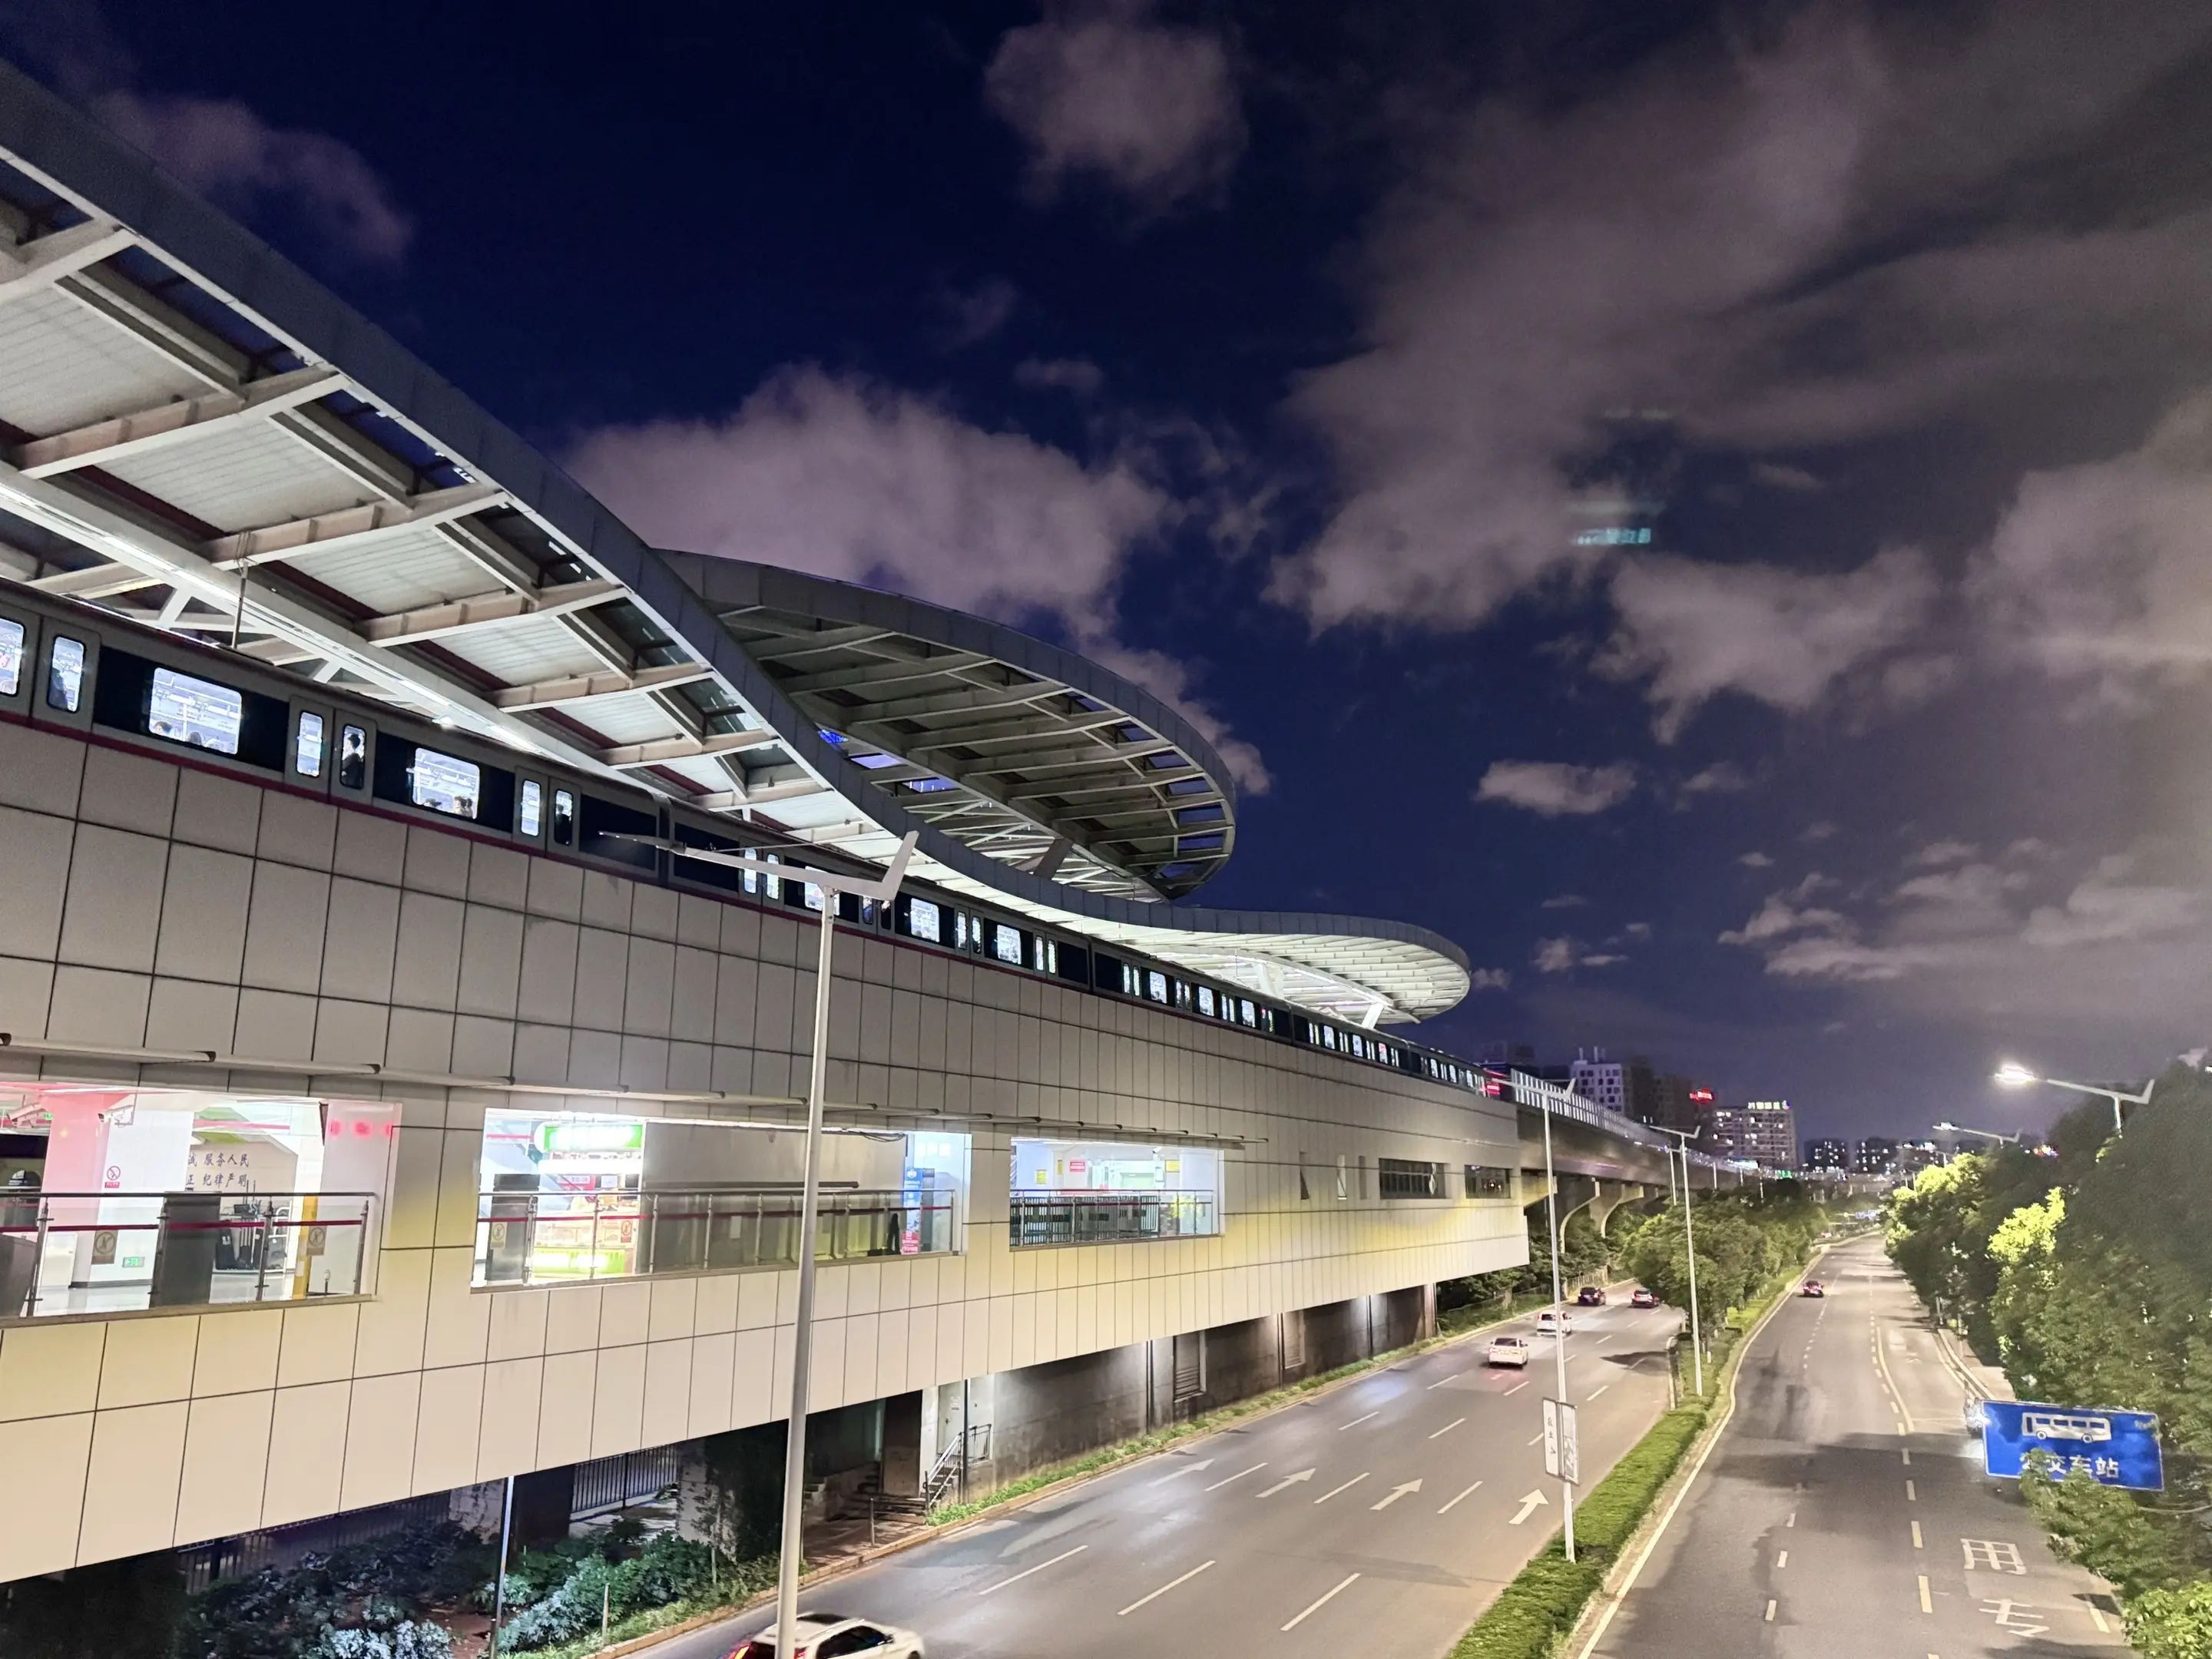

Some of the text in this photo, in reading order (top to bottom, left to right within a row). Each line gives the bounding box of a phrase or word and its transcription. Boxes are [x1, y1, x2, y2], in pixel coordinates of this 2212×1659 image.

[204, 1152, 250, 1167] 服务人民
[202, 1173, 248, 1189] 纪律严明
